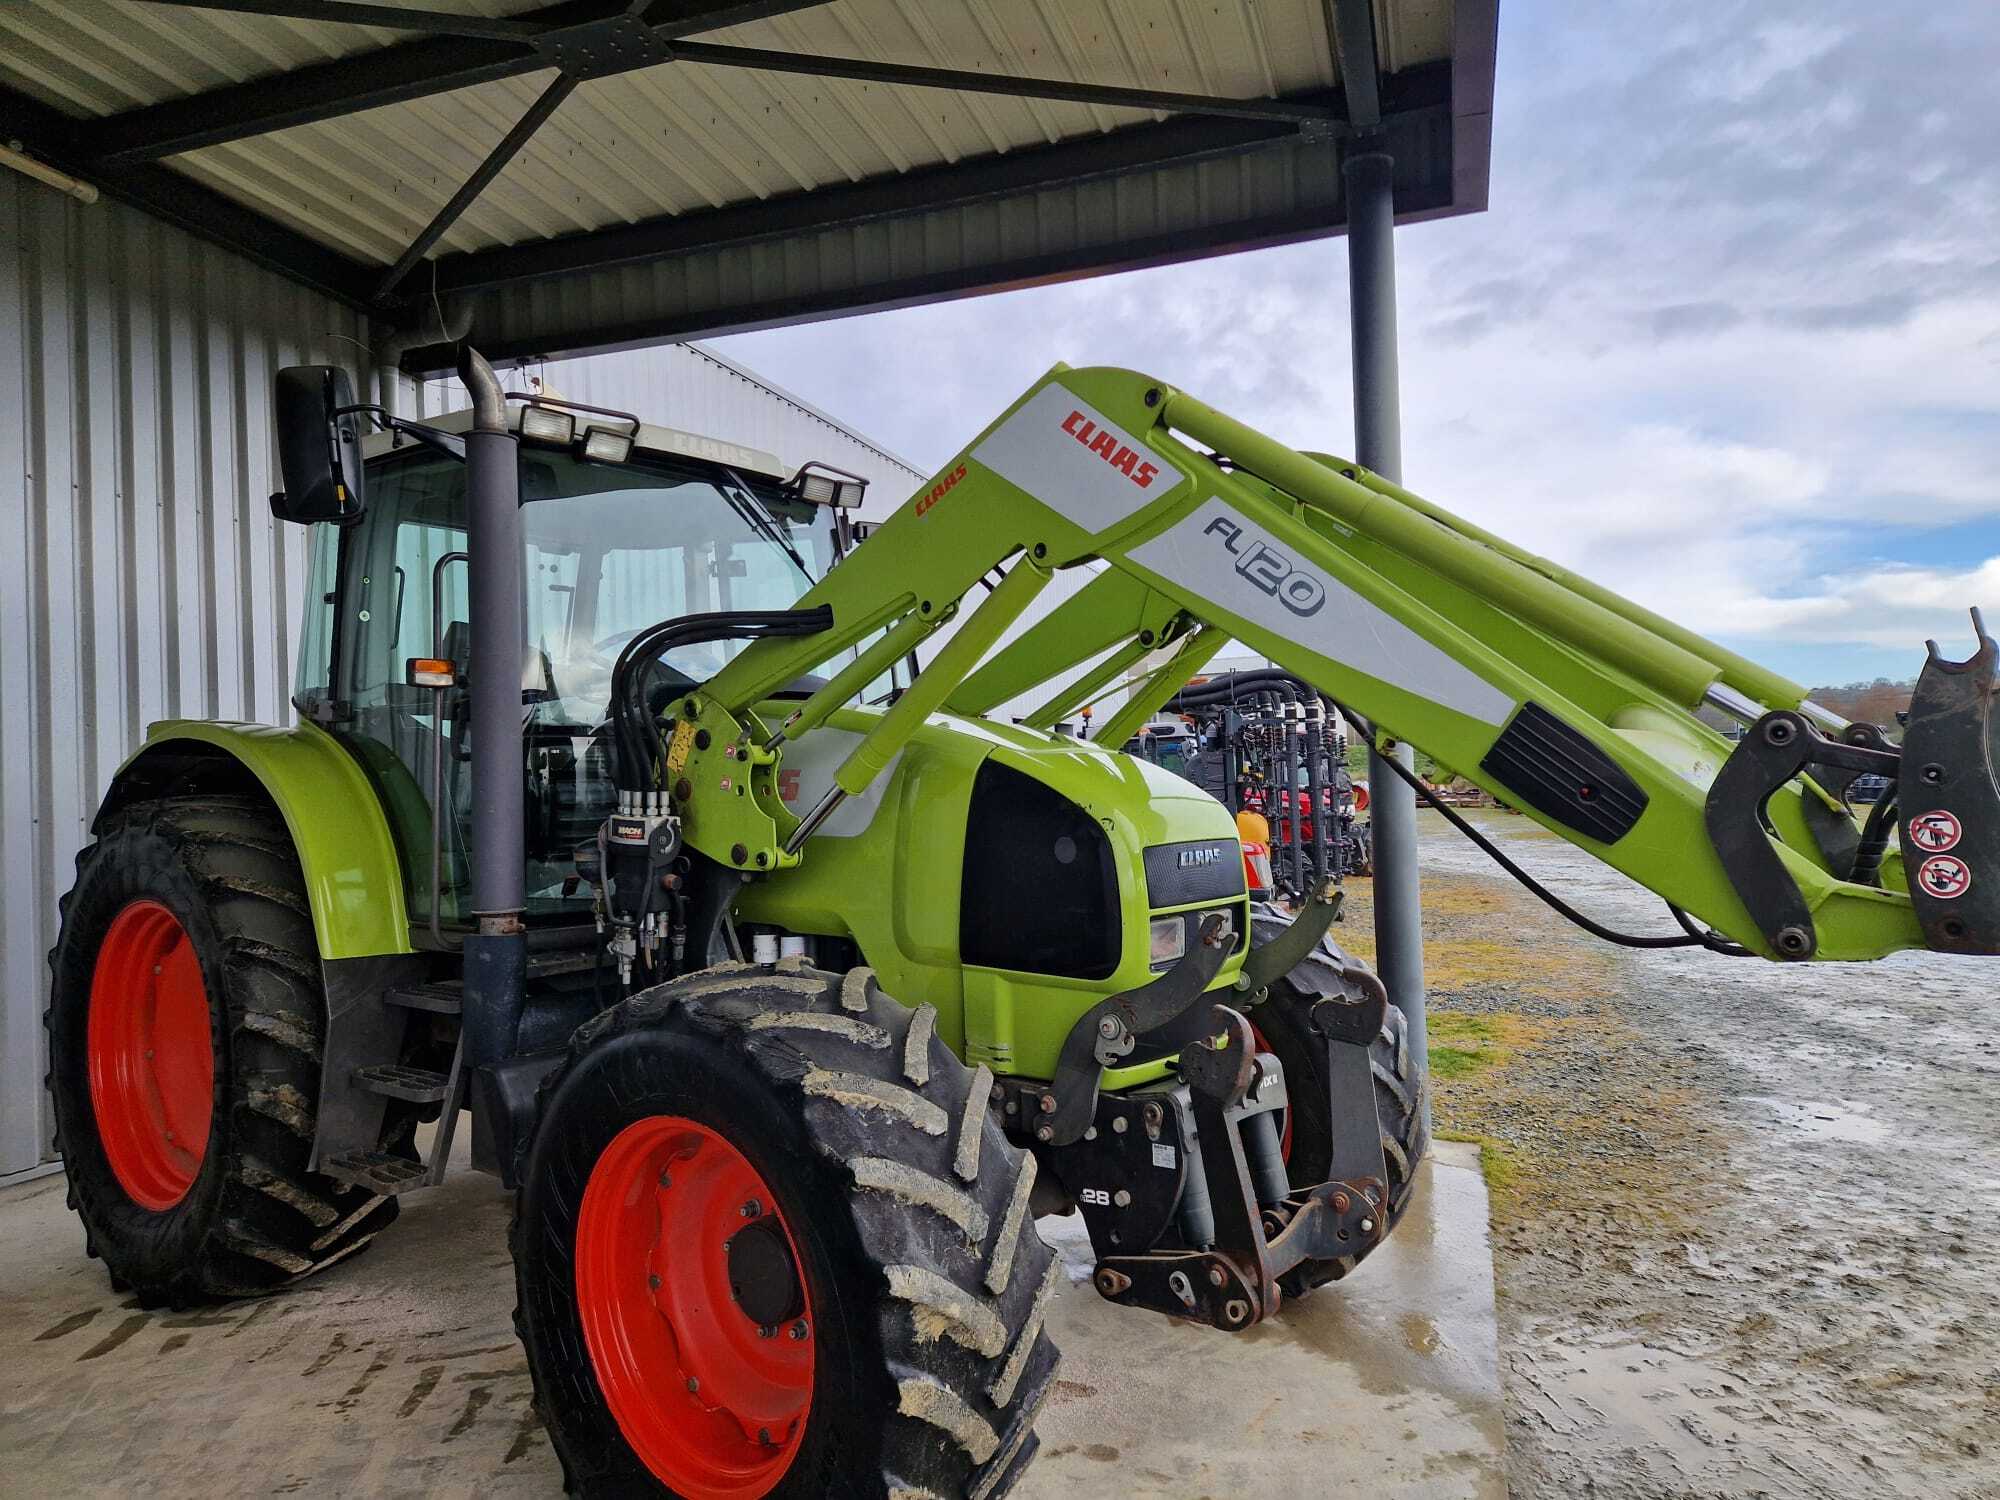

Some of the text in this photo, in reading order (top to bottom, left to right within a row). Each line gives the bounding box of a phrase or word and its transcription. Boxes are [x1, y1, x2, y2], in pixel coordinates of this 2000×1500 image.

[672, 432, 752, 464] CLAAS
[1061, 410, 1159, 488] CLAAS
[915, 463, 967, 517] CLAAS
[1179, 848, 1222, 867] CLAAS
